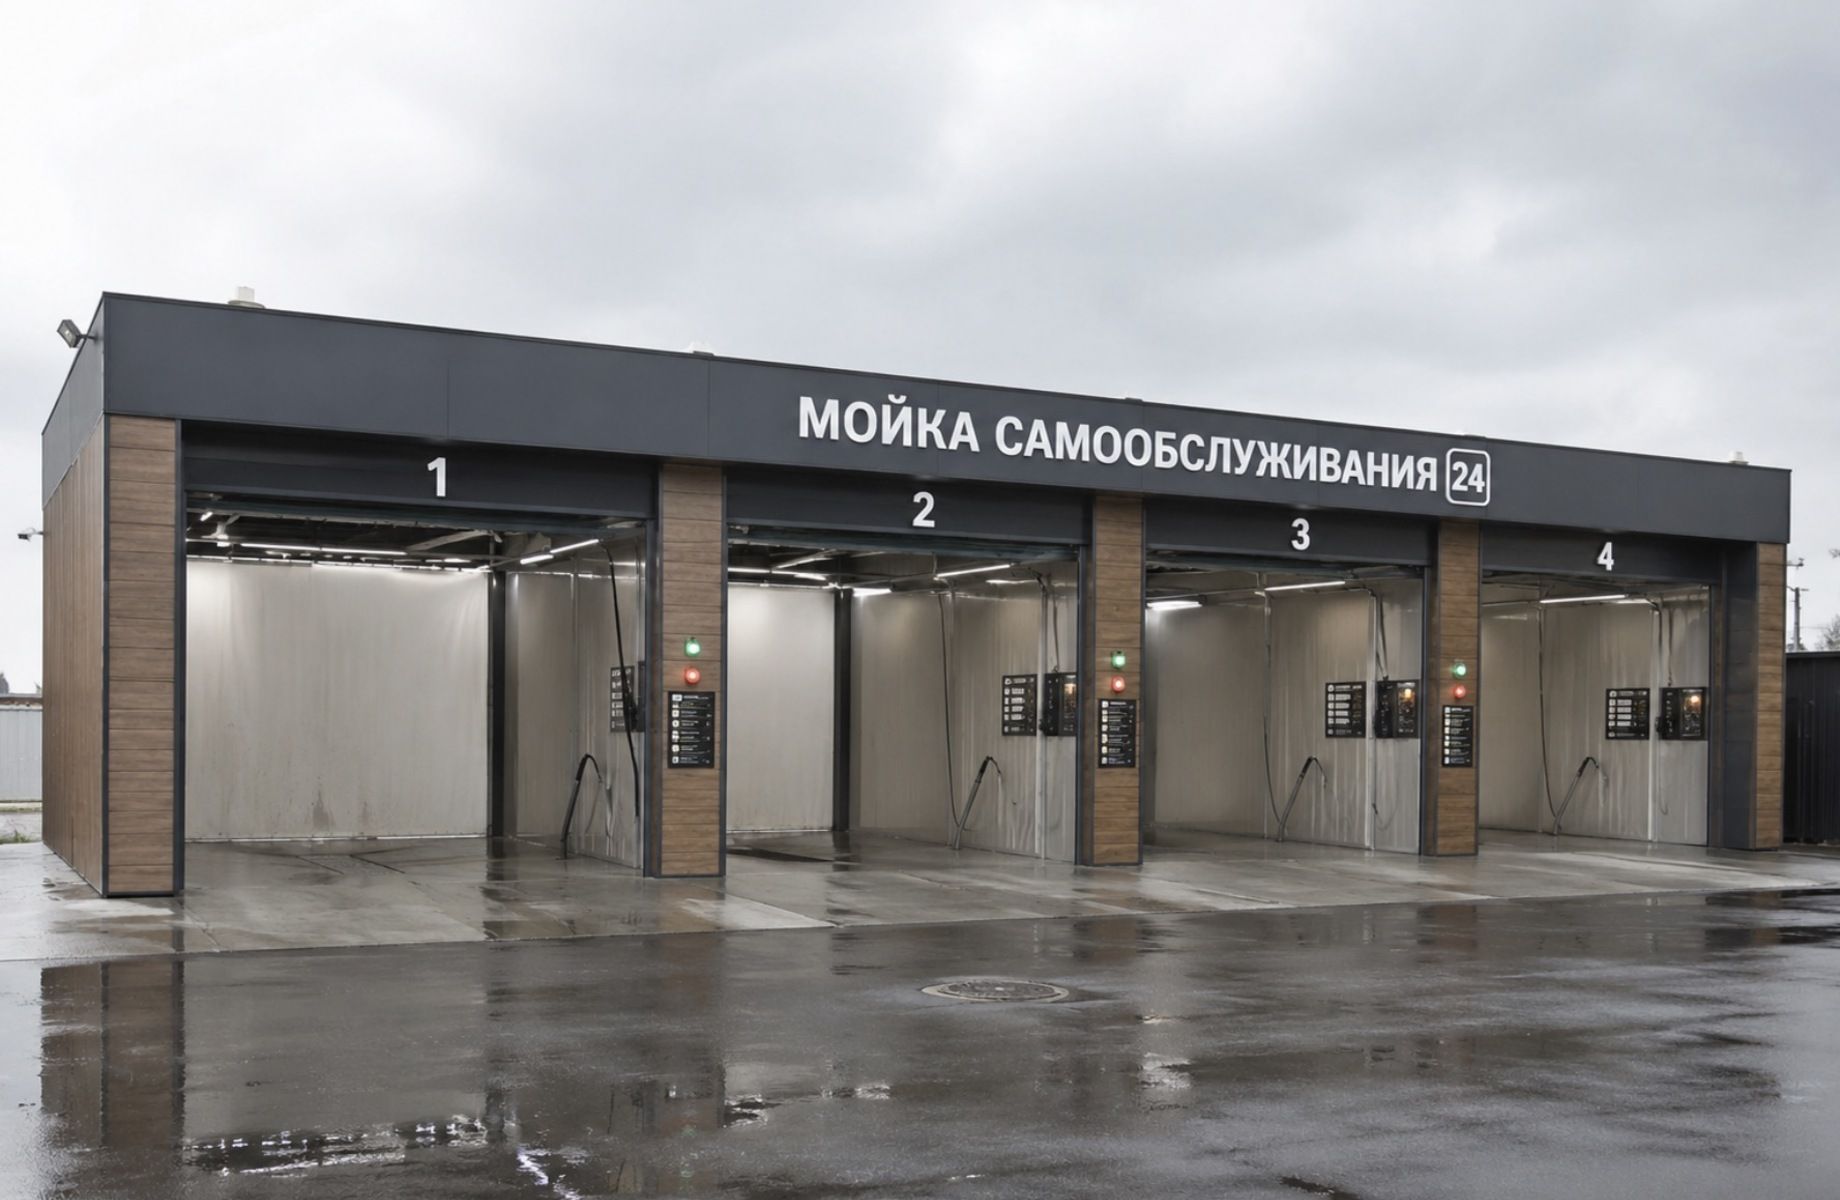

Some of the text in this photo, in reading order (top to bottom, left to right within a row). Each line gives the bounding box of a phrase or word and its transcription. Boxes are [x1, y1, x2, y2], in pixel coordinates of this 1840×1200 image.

[798, 393, 1486, 493] МОЙКА САМООБСЛУЖИВАНИЯ 24
[427, 457, 446, 497] 1
[912, 491, 935, 528] 2
[1291, 518, 1310, 551] 3
[1597, 542, 1615, 571] 4
